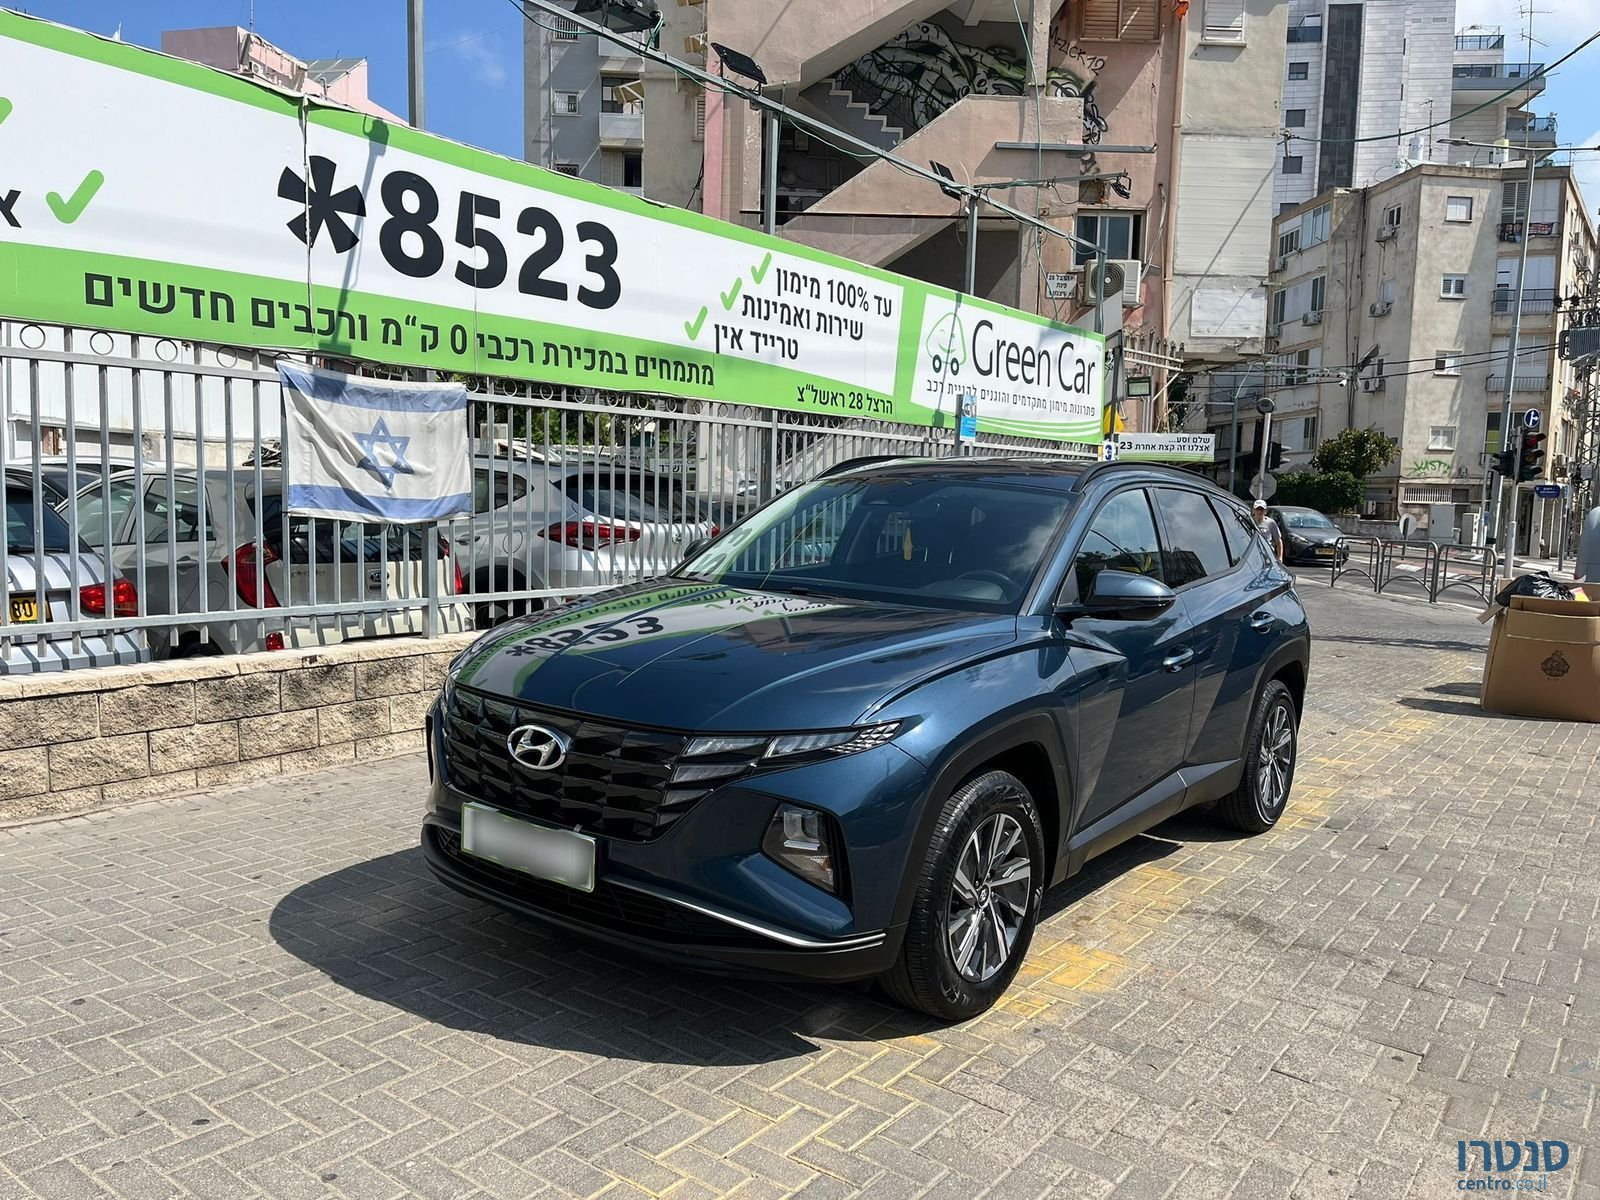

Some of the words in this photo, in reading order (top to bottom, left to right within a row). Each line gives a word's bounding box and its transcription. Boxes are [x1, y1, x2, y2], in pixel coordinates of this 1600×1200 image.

[84, 272, 235, 323] חדשים
[776, 268, 821, 300] מימון
[827, 279, 869, 312] 100%
[250, 297, 368, 342] ורכבים
[742, 294, 810, 330] ואמינות
[874, 294, 892, 318] עד
[450, 324, 467, 355] 0
[714, 323, 743, 354] אין
[816, 312, 864, 341] שירות
[476, 333, 534, 364] רכבי
[542, 341, 628, 375] במכירת
[750, 330, 799, 361] טרייד
[971, 319, 1051, 388] Green
[1058, 341, 1096, 395] Car
[635, 355, 714, 386] מתמחים
[848, 392, 863, 410] 28
[866, 393, 893, 415] הרצל
[980, 388, 1010, 403] והוגנים
[1013, 394, 1047, 410] מתקדמים
[1050, 400, 1067, 413] מימון
[1069, 403, 1096, 417] פתרונות
[1120, 441, 1133, 450] 23
[1158, 444, 1175, 453] קצת
[1176, 444, 1187, 452] זה
[1187, 443, 1210, 452] אצלנו
